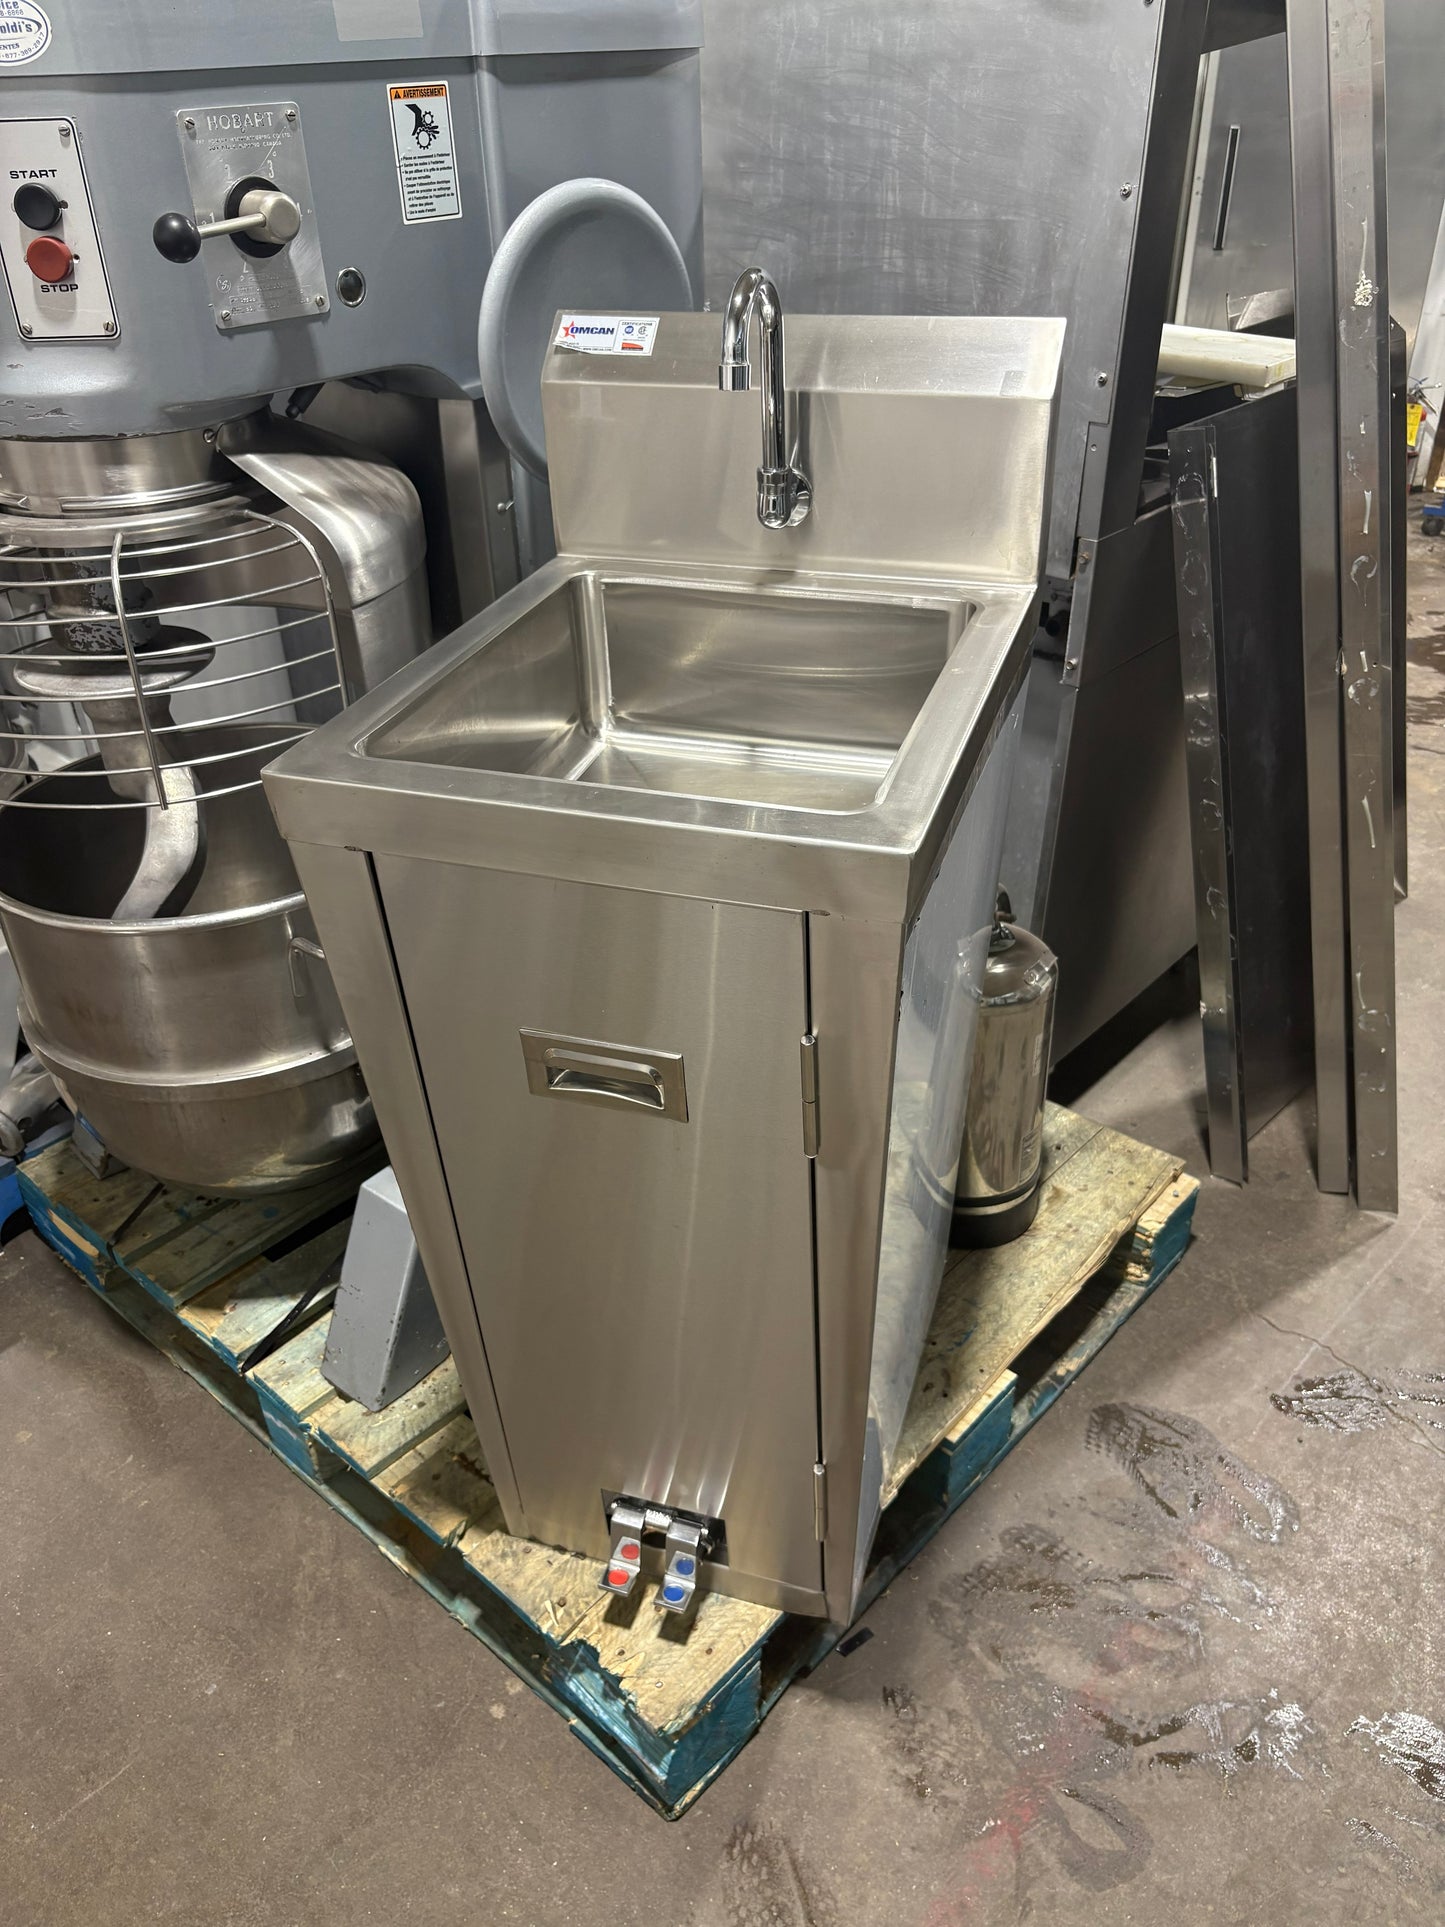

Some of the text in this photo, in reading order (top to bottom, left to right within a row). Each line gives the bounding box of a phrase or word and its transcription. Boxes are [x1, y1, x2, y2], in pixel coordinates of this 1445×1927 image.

[0, 0, 19, 9] ice
[0, 21, 32, 33] oldi's
[402, 87, 443, 98] AVERTISSEMENT
[206, 112, 273, 130] HOBART
[9, 169, 57, 179] START
[41, 283, 79, 293] STOP
[570, 326, 615, 335] OMCAN
